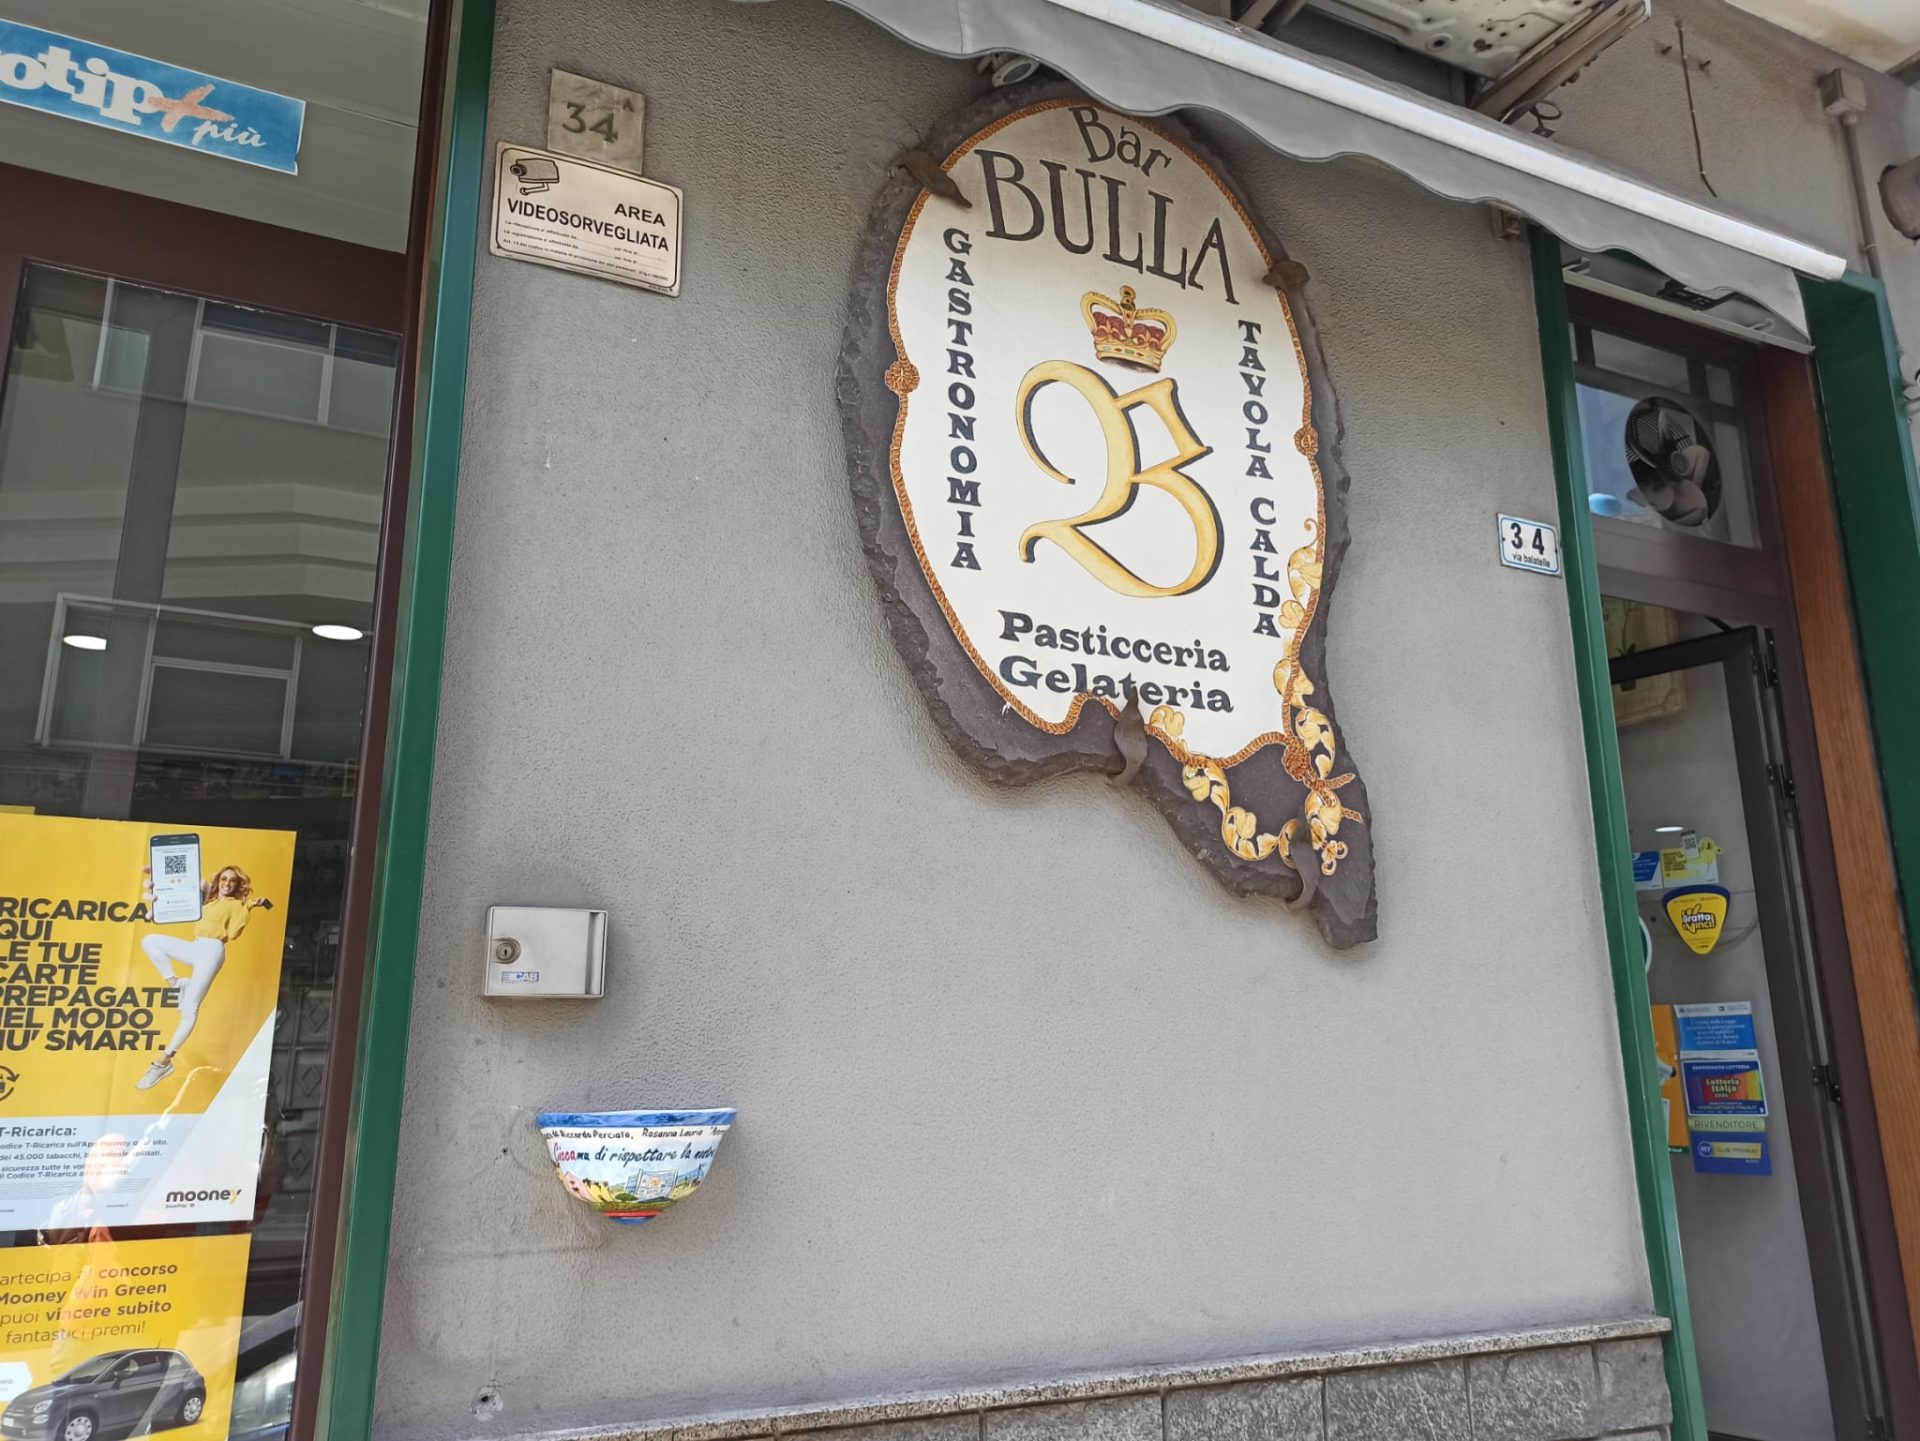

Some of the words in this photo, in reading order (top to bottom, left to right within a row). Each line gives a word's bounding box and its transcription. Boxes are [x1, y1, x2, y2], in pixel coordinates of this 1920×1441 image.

[562, 101, 619, 143] 34
[1068, 106, 1172, 177] Bar
[507, 198, 669, 251] VIDEOSORVEGLIATA
[614, 203, 667, 227] AREA
[974, 149, 1239, 305] BULLA
[942, 227, 981, 571] GASTRONOMIA
[1238, 319, 1274, 480] TAVOLA
[1510, 522, 1545, 555] 34
[1249, 497, 1281, 638] CALDA
[998, 609, 1231, 673] Pasticceria
[999, 656, 1234, 714] Gelateria
[0, 896, 152, 923] RICARICA
[0, 918, 53, 940] QUI
[38, 941, 102, 965] TUE
[0, 985, 180, 1009] REPAGATE
[0, 1007, 44, 1028] EL
[52, 1007, 153, 1030] MODO
[45, 1029, 166, 1051] SMART.
[1694, 1119, 1759, 1129] RIVENDITORE
[594, 1145, 609, 1161] di
[166, 1189, 242, 1205] mooney
[0, 1270, 71, 1287] artecipa
[98, 1264, 178, 1279] concorso
[115, 1283, 167, 1297] Green
[0, 1312, 38, 1328] puoi
[46, 1306, 111, 1321] vincere
[117, 1300, 172, 1316] subito
[6, 1325, 86, 1345] fantastici
[91, 1320, 146, 1340] premi!
